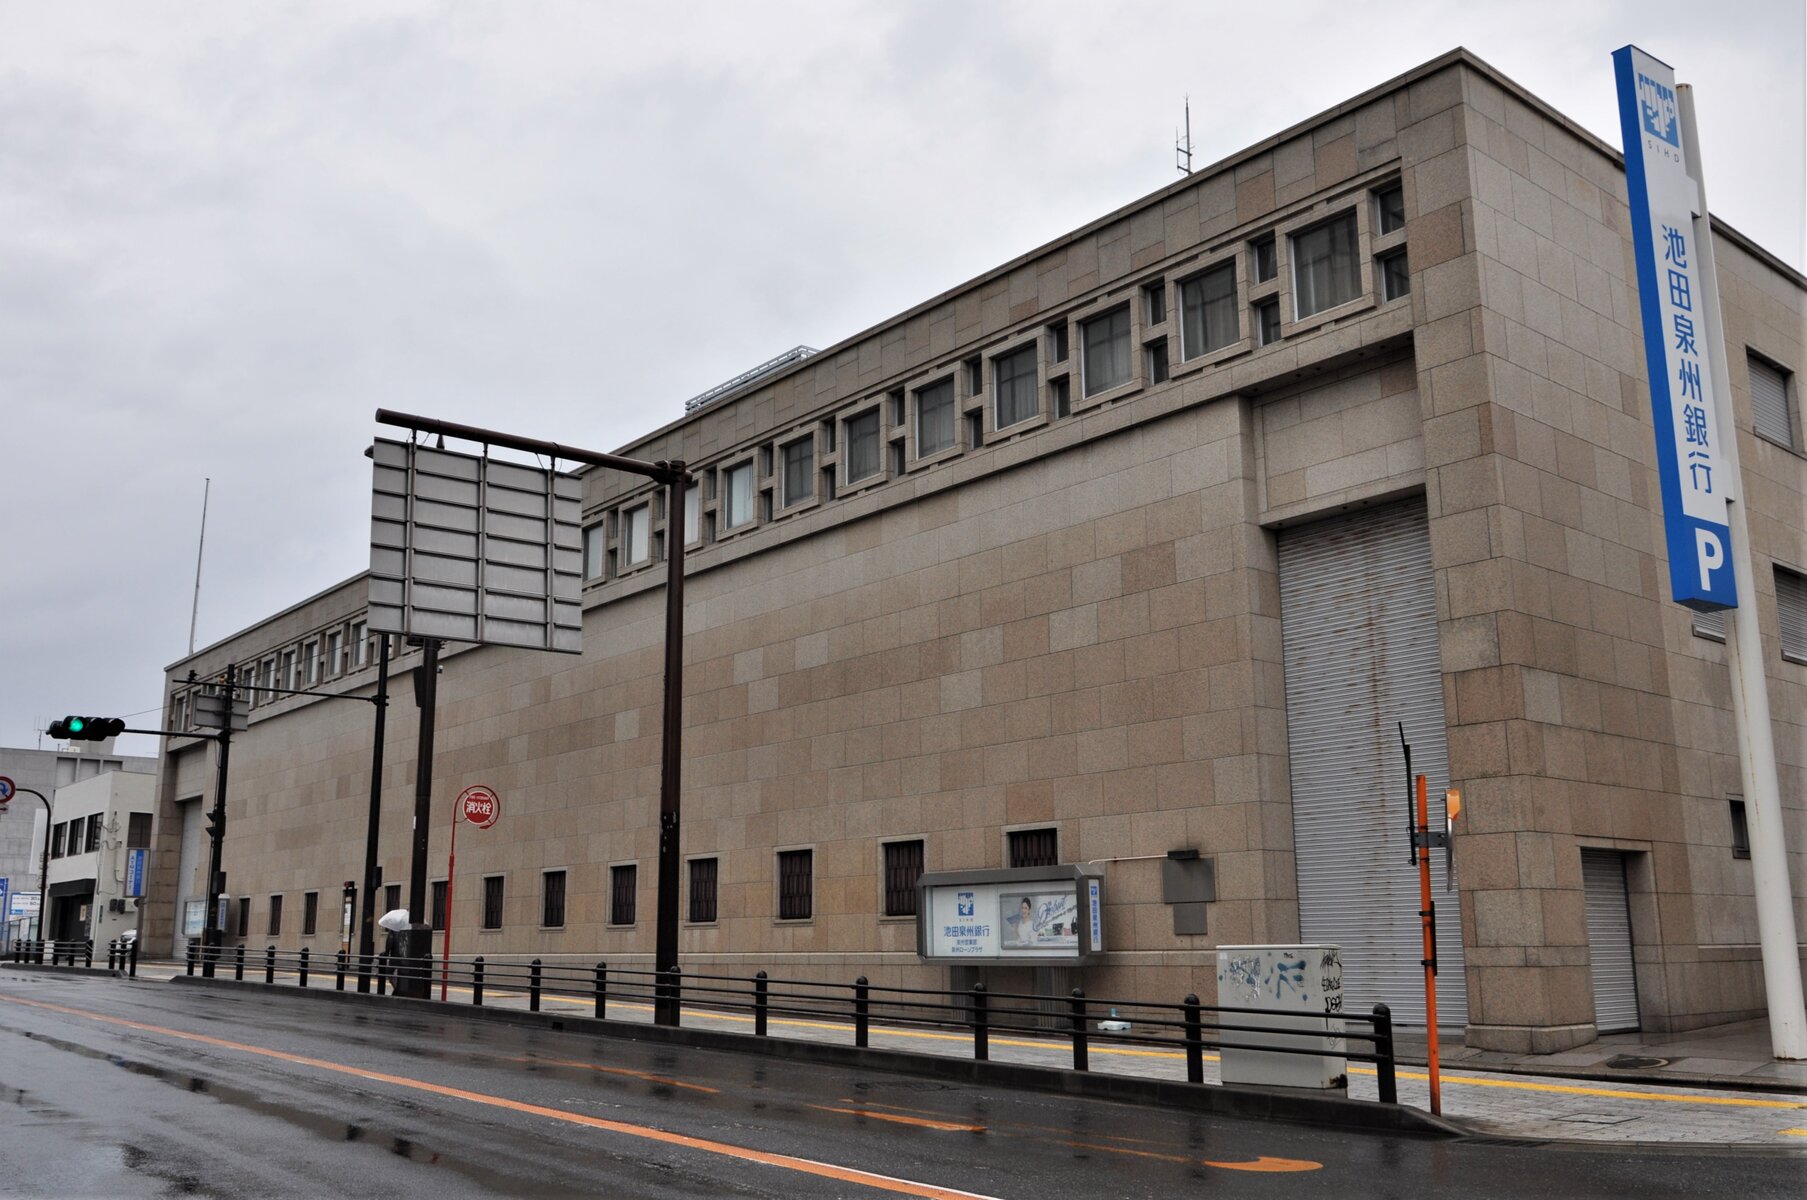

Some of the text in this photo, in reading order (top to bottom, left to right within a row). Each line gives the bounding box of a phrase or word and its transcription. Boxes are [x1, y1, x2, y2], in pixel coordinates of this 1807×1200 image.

[1647, 139, 1681, 164] SIHD
[1661, 224, 1713, 494] 池田泉州銀行
[1694, 526, 1725, 592] P
[466, 801, 492, 815] 消火栓
[943, 925, 990, 938] 池田泉州銀行
